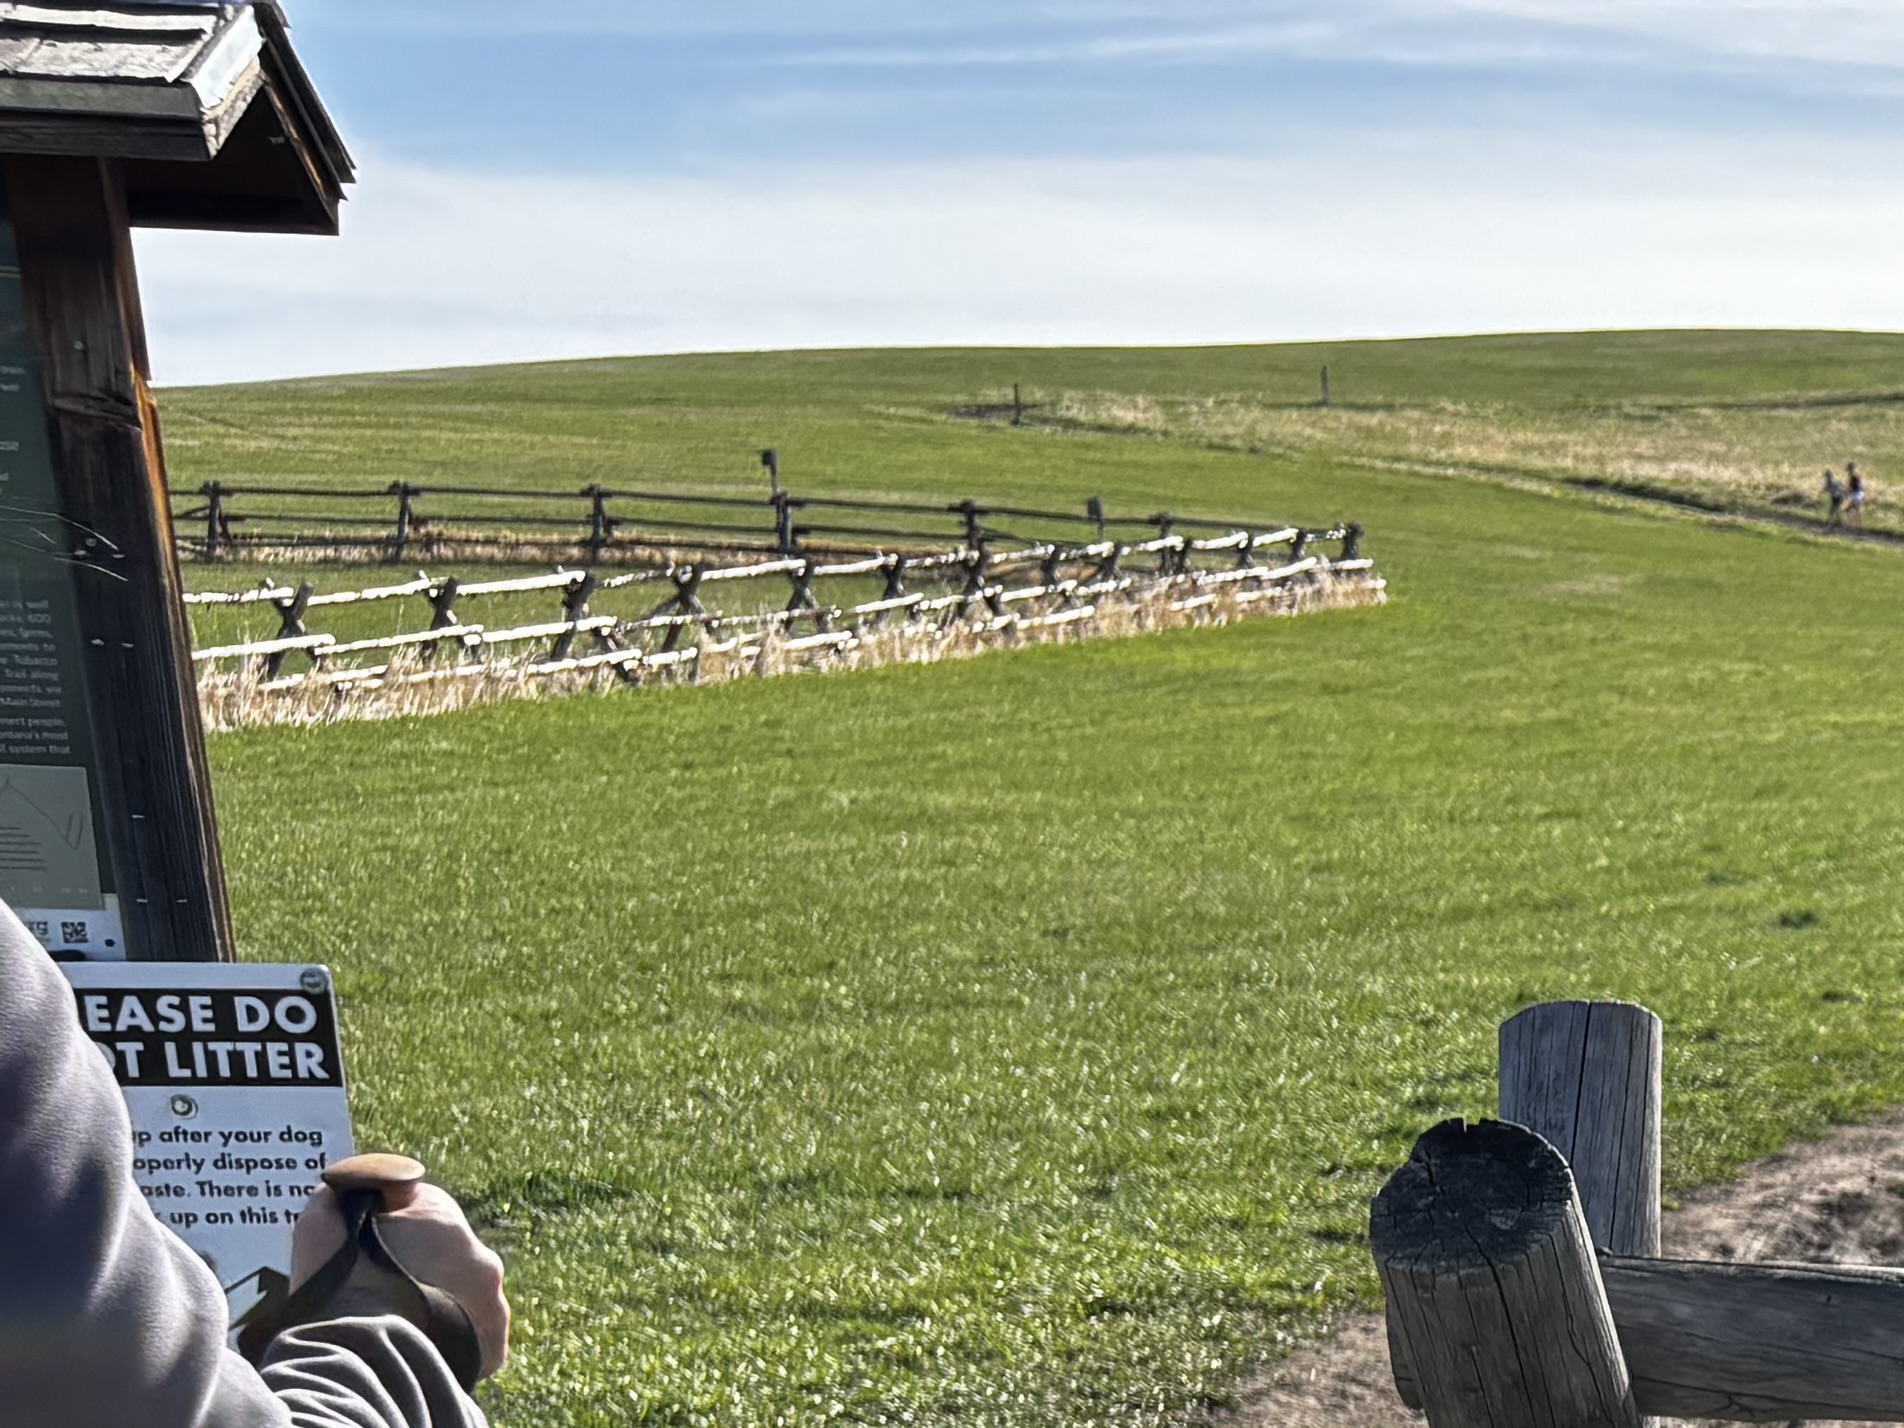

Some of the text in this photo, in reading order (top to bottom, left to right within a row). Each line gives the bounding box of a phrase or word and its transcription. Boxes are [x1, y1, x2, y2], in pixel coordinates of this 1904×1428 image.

[84, 995, 317, 1034] EASE DO
[164, 1042, 329, 1079] LITTER
[159, 1125, 212, 1143] after
[219, 1130, 272, 1147] your
[279, 1125, 322, 1147] dog
[133, 1153, 327, 1175] operly dispose of
[141, 1183, 191, 1198] aste.
[196, 1180, 259, 1198] There
[265, 1180, 282, 1198] is
[170, 1212, 198, 1228] up
[205, 1212, 233, 1224] on
[240, 1207, 278, 1224] this
